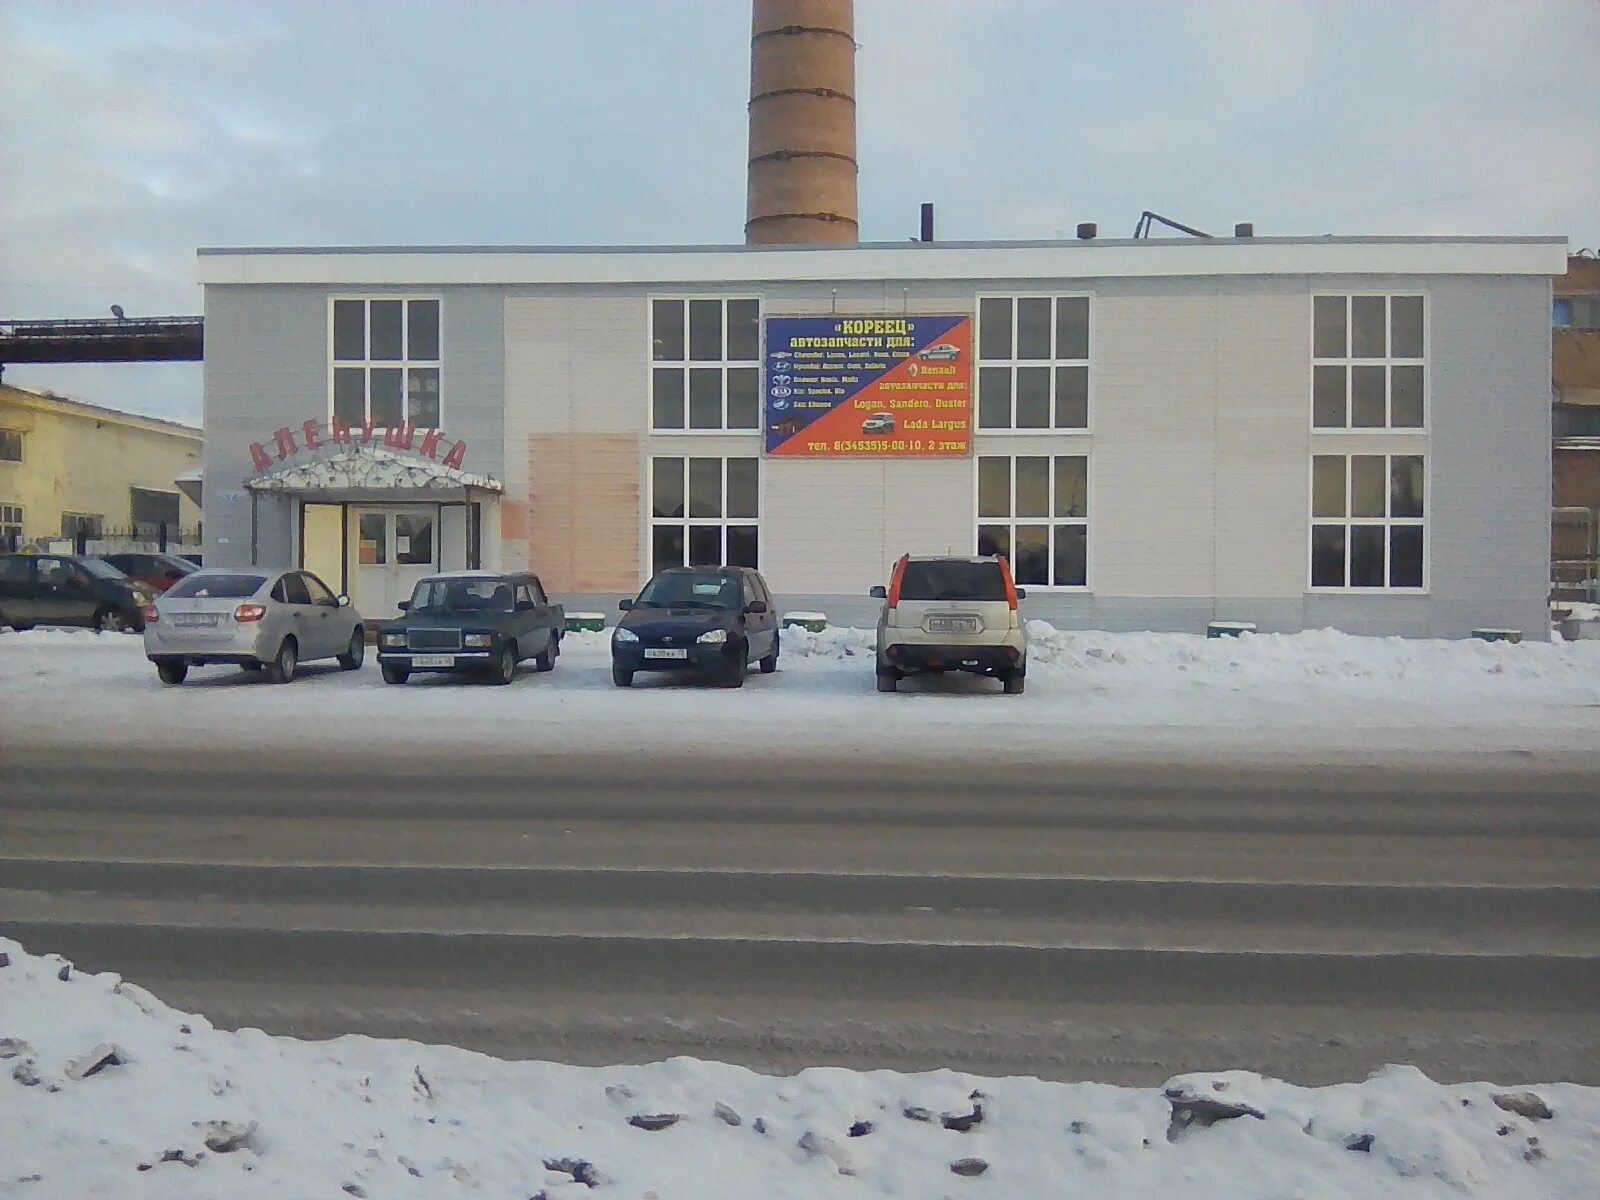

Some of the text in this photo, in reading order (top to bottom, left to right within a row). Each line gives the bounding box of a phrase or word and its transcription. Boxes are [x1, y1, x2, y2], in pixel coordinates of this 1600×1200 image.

[834, 319, 915, 335] «КОРЕЕЦ»
[790, 336, 915, 348] автозапчасти для:
[920, 365, 956, 375] Renault
[879, 382, 945, 390] автозапчасти
[854, 399, 967, 410] Logan, Sandero, Duster
[903, 418, 967, 430] Lada Largus
[808, 441, 830, 451] тел.
[928, 440, 935, 451] 2
[938, 441, 967, 451] этаж
